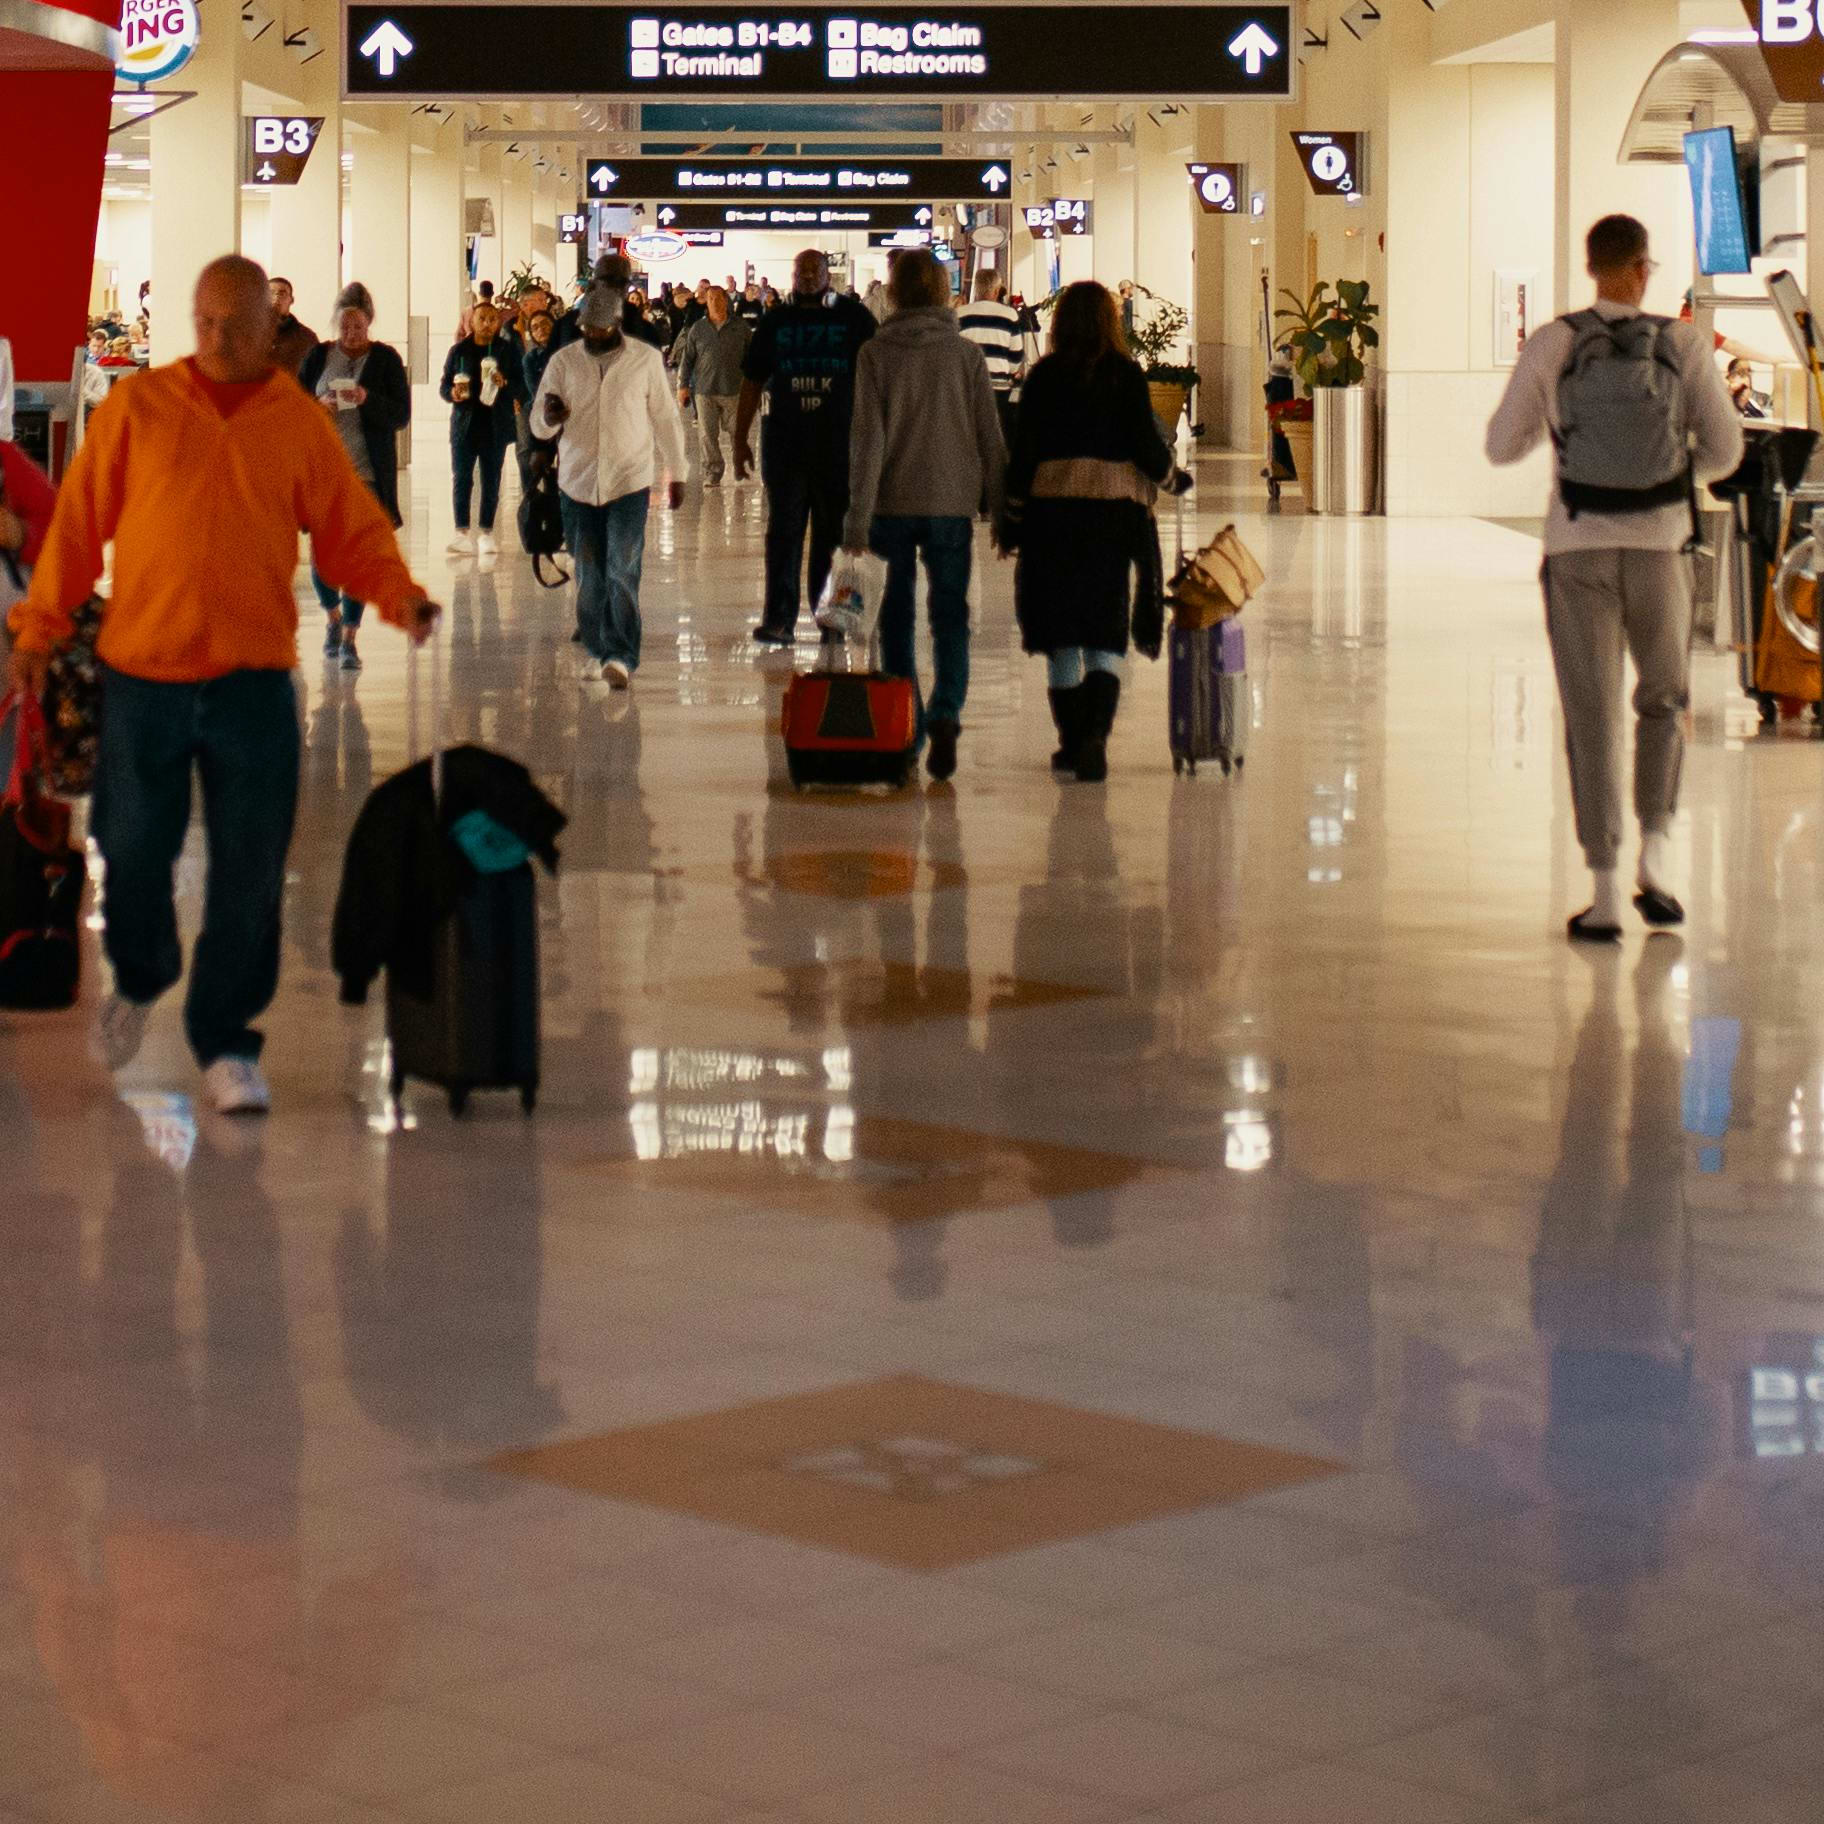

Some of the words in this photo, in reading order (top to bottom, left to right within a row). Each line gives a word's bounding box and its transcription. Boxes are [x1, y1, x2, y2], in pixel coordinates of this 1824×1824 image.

[126, 8, 184, 48] ING
[662, 23, 733, 46] Gates
[738, 23, 812, 46] B1-B4
[860, 23, 908, 51] Bag
[912, 23, 981, 46] Claim
[662, 52, 762, 76] Terminal
[860, 51, 986, 74] Restrooms
[255, 119, 309, 154] B3
[1299, 135, 1332, 144] Women
[692, 173, 725, 186] Gates
[783, 173, 830, 186] Terminal
[852, 173, 875, 187] Bag
[877, 173, 910, 185] Claim
[1027, 208, 1054, 226] B2
[1055, 200, 1085, 220] B4
[562, 215, 584, 232] B1
[776, 325, 847, 347] SIZE
[791, 377, 833, 393] BULK
[800, 396, 822, 412] UP
